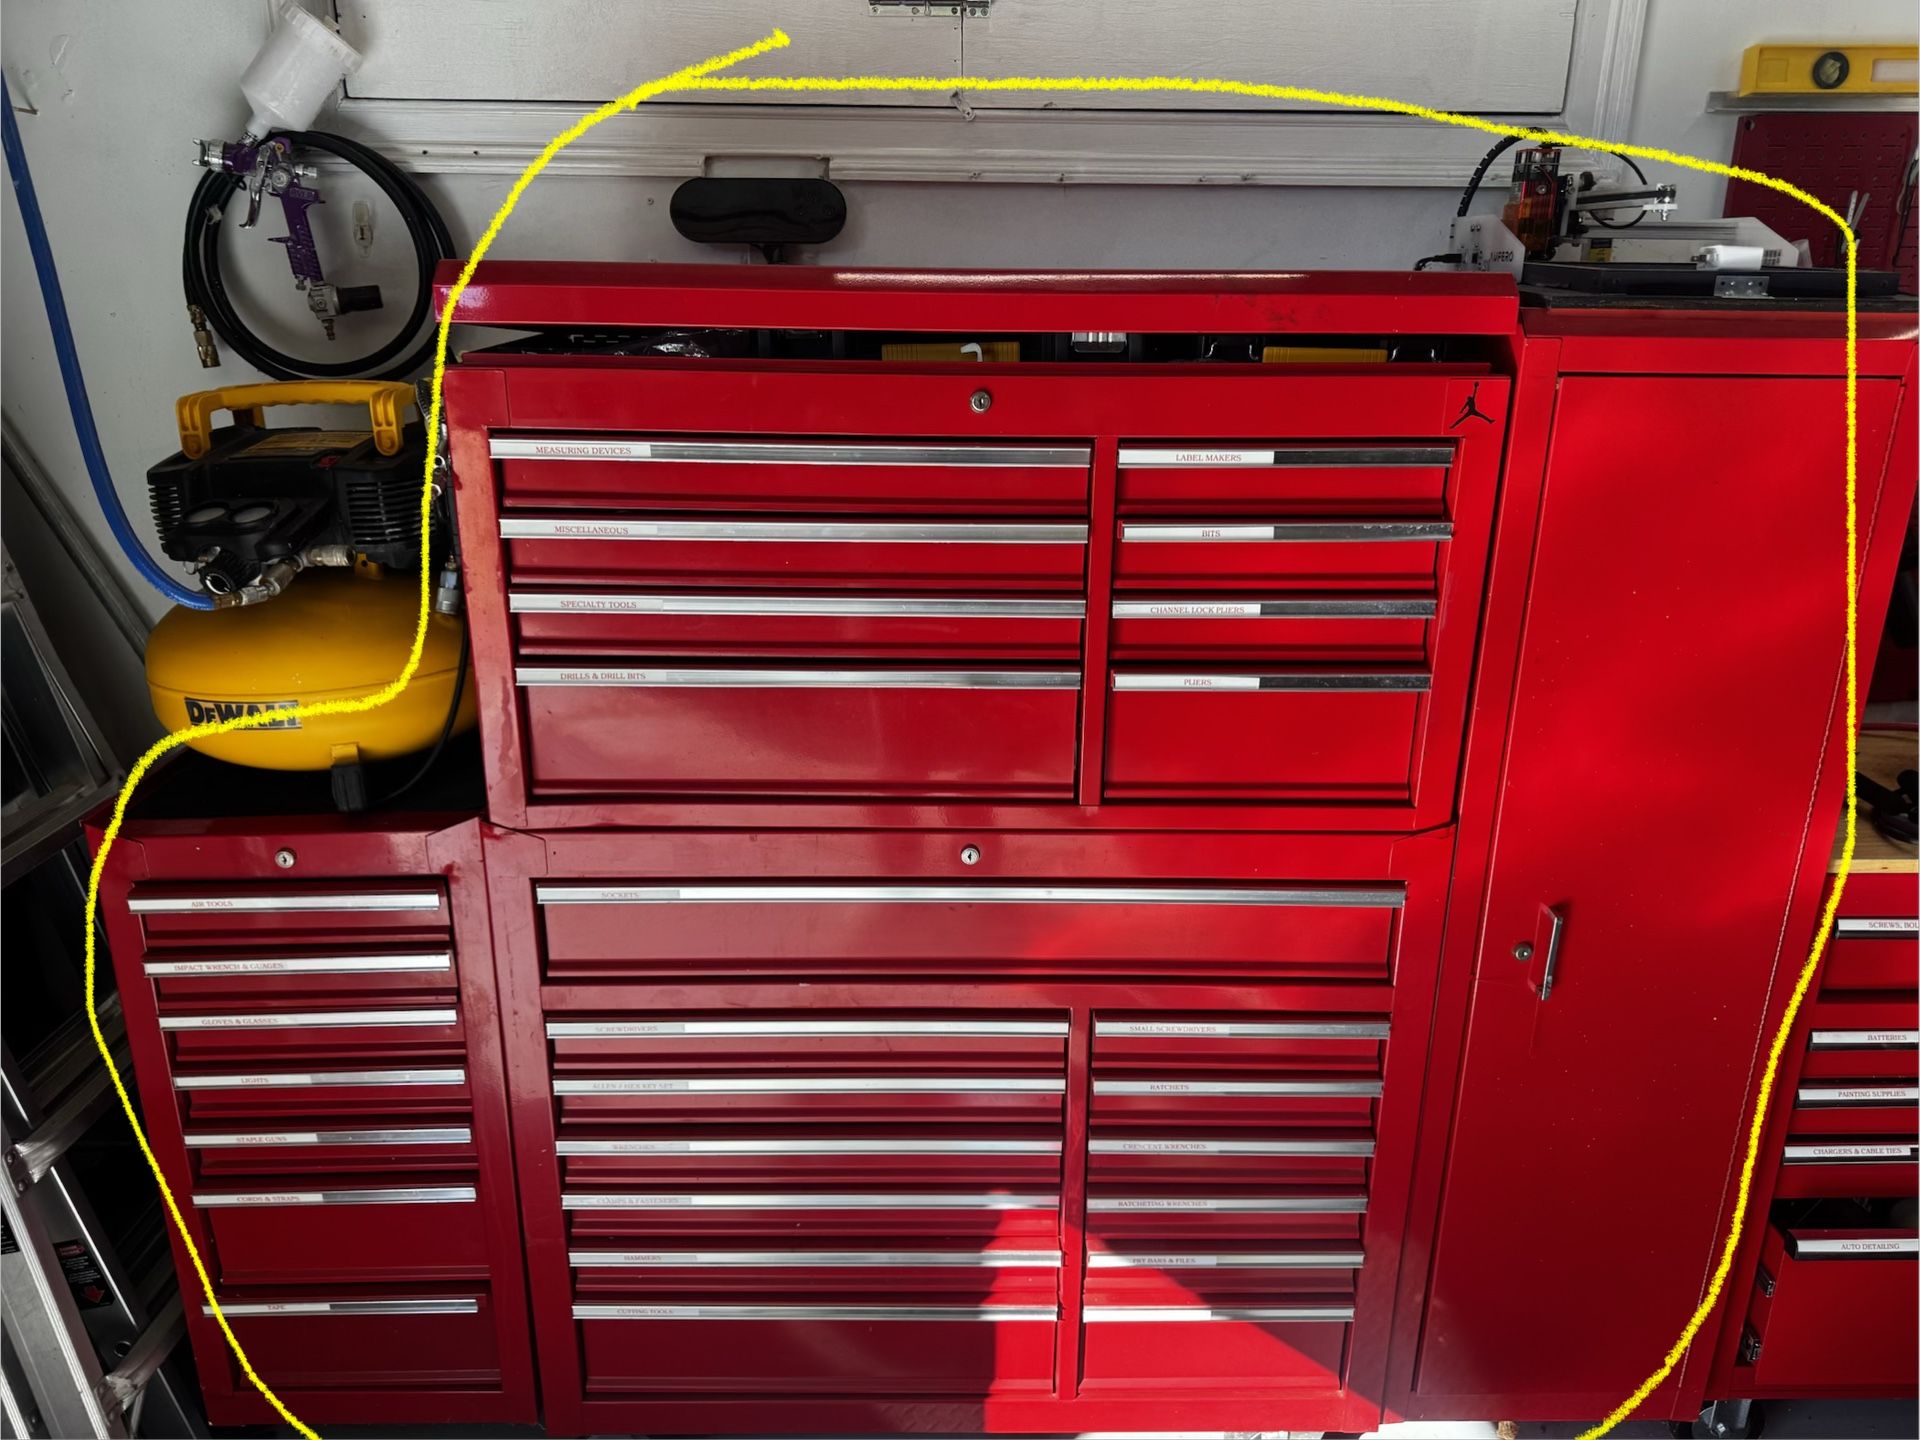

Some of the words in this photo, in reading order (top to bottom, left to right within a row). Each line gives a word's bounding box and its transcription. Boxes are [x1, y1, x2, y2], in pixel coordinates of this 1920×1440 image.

[536, 446, 589, 455] MEASURING
[592, 447, 631, 456] DEVICES
[1176, 454, 1203, 462] LABEL
[1205, 454, 1241, 462] MAKERS
[554, 526, 628, 535] MISCELLANEOUS
[560, 601, 605, 609] SPECIALTY
[608, 601, 637, 609] TOOLS
[1151, 606, 1190, 614] CHANNEL
[1191, 606, 1215, 614] LOCK
[1216, 606, 1245, 614] PLIERS
[560, 672, 590, 680] DRILLS
[592, 672, 599, 680] &
[601, 672, 625, 680] DRILL
[627, 672, 646, 680] BITS
[601, 891, 639, 899] SOCKETS
[206, 900, 233, 908] TOOLS
[1868, 921, 1903, 930] SCREWS,
[174, 964, 204, 972] IMPACT
[206, 963, 241, 971] WRENCH
[242, 962, 249, 970] &
[250, 962, 284, 970] GUAGES
[201, 1018, 234, 1026] GLOVES
[243, 1017, 278, 1025] GLASSES
[595, 1025, 658, 1033] SCREWDRIVERS
[1156, 1025, 1216, 1033] SCREWDRIVERS
[1867, 1034, 1907, 1042] BATTERIES
[1150, 1083, 1190, 1091] RATCHETS
[1872, 1090, 1906, 1098] SUPPLIES
[236, 1136, 263, 1144] STAPLE
[1813, 1148, 1853, 1156] CHARGERS
[1861, 1147, 1884, 1155] CABLE
[1841, 1243, 1861, 1251] AUTO
[1862, 1243, 1899, 1251] DETAILING
[1175, 1256, 1196, 1264] FILES
